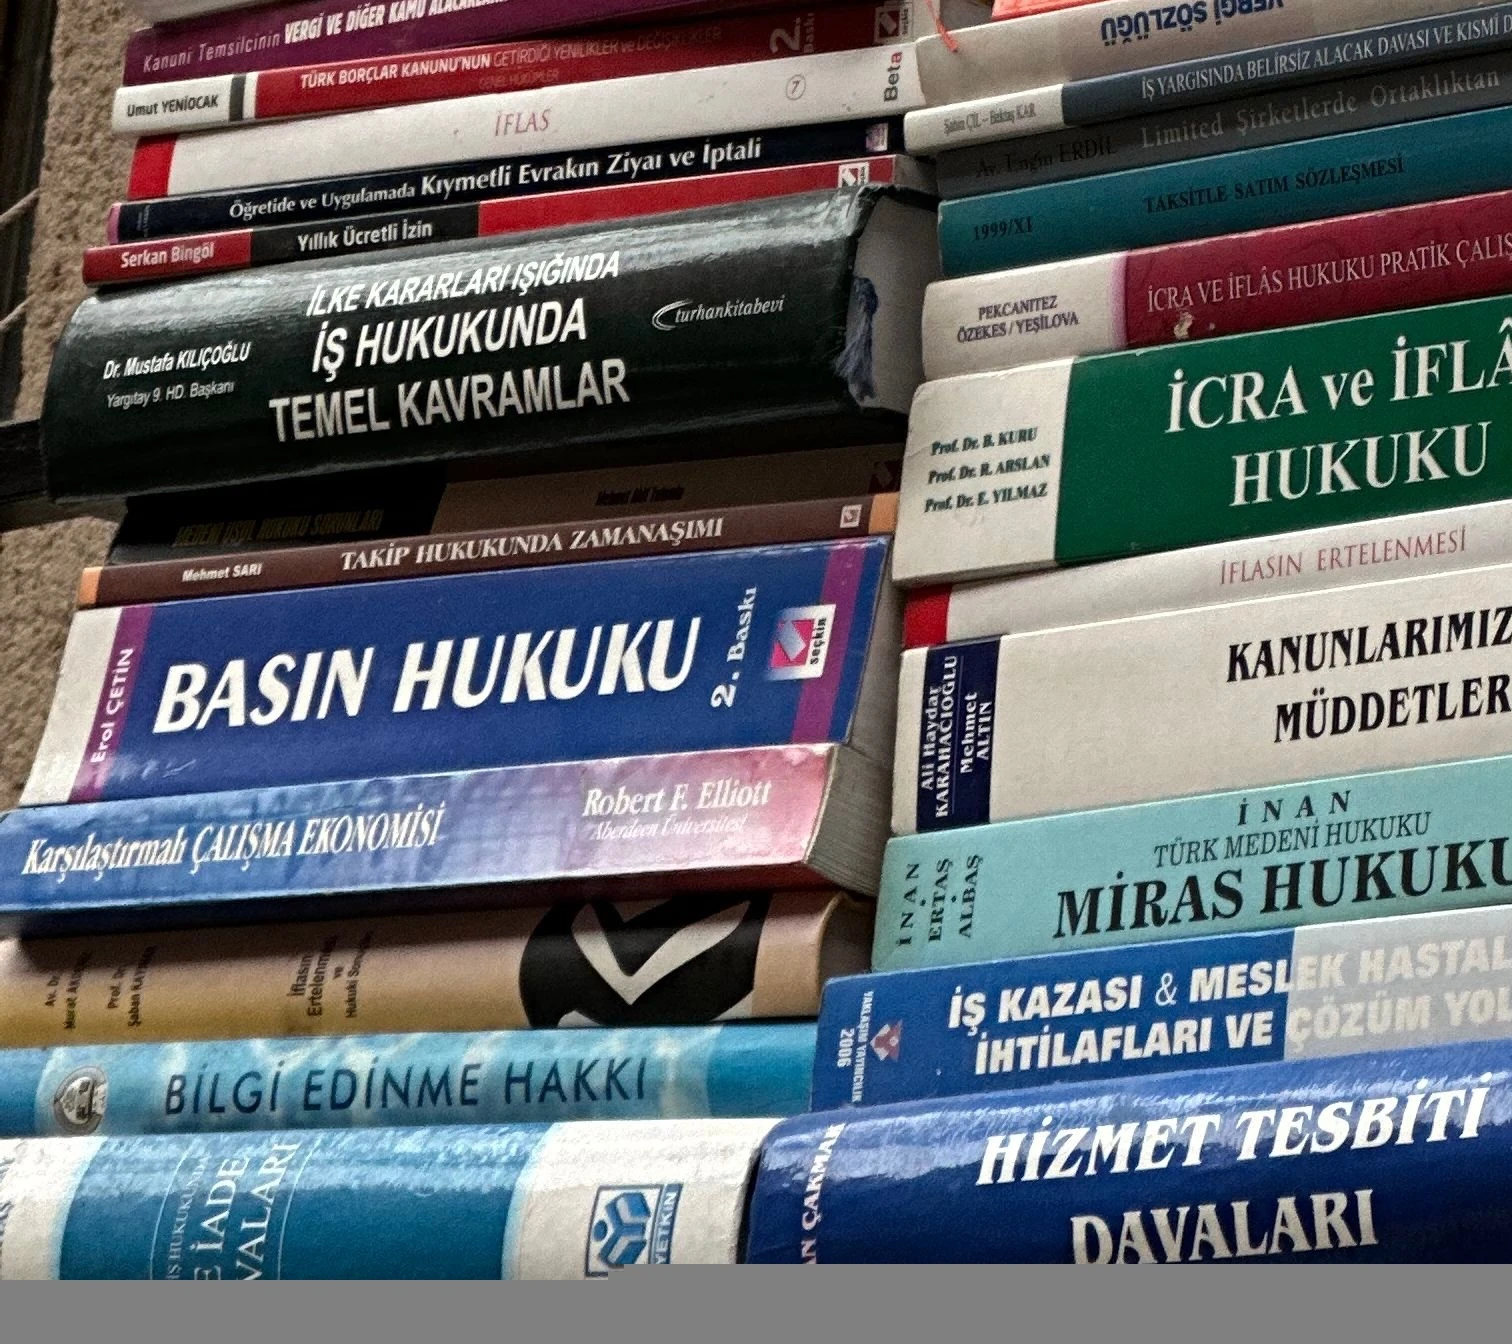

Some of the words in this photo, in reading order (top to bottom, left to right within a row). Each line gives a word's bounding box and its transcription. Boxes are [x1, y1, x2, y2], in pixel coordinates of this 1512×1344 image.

[421, 166, 512, 201] Kıymetli
[518, 159, 599, 186] Evrakın
[606, 146, 663, 177] Ziyaı
[669, 146, 696, 168] ve
[701, 135, 761, 170] İptali
[297, 226, 337, 251] Yıllık
[342, 220, 397, 247] Ücretli
[402, 218, 433, 240] İzin
[314, 323, 347, 379] İŞ
[357, 298, 587, 368] HUKUKUNDA
[270, 388, 390, 443] TEMEL
[399, 358, 630, 430] KAVRAMLAR
[1165, 367, 1306, 434] İCRA
[1321, 373, 1374, 410] ve
[1231, 421, 1492, 508] HUKUKU
[155, 646, 375, 735] BASIN
[393, 617, 701, 717] HUKUKU
[711, 671, 740, 708] 2.
[726, 585, 757, 662] Baskı
[1274, 673, 1512, 742] MÜDDETLER
[1054, 871, 1257, 939] MİRAS
[165, 1061, 279, 1114] BİLGİ
[303, 1061, 480, 1111] EDİNME
[505, 1057, 649, 1104] HAKKI
[976, 1110, 1227, 1186] HİZMET
[1237, 1078, 1491, 1162] TESBİTİ
